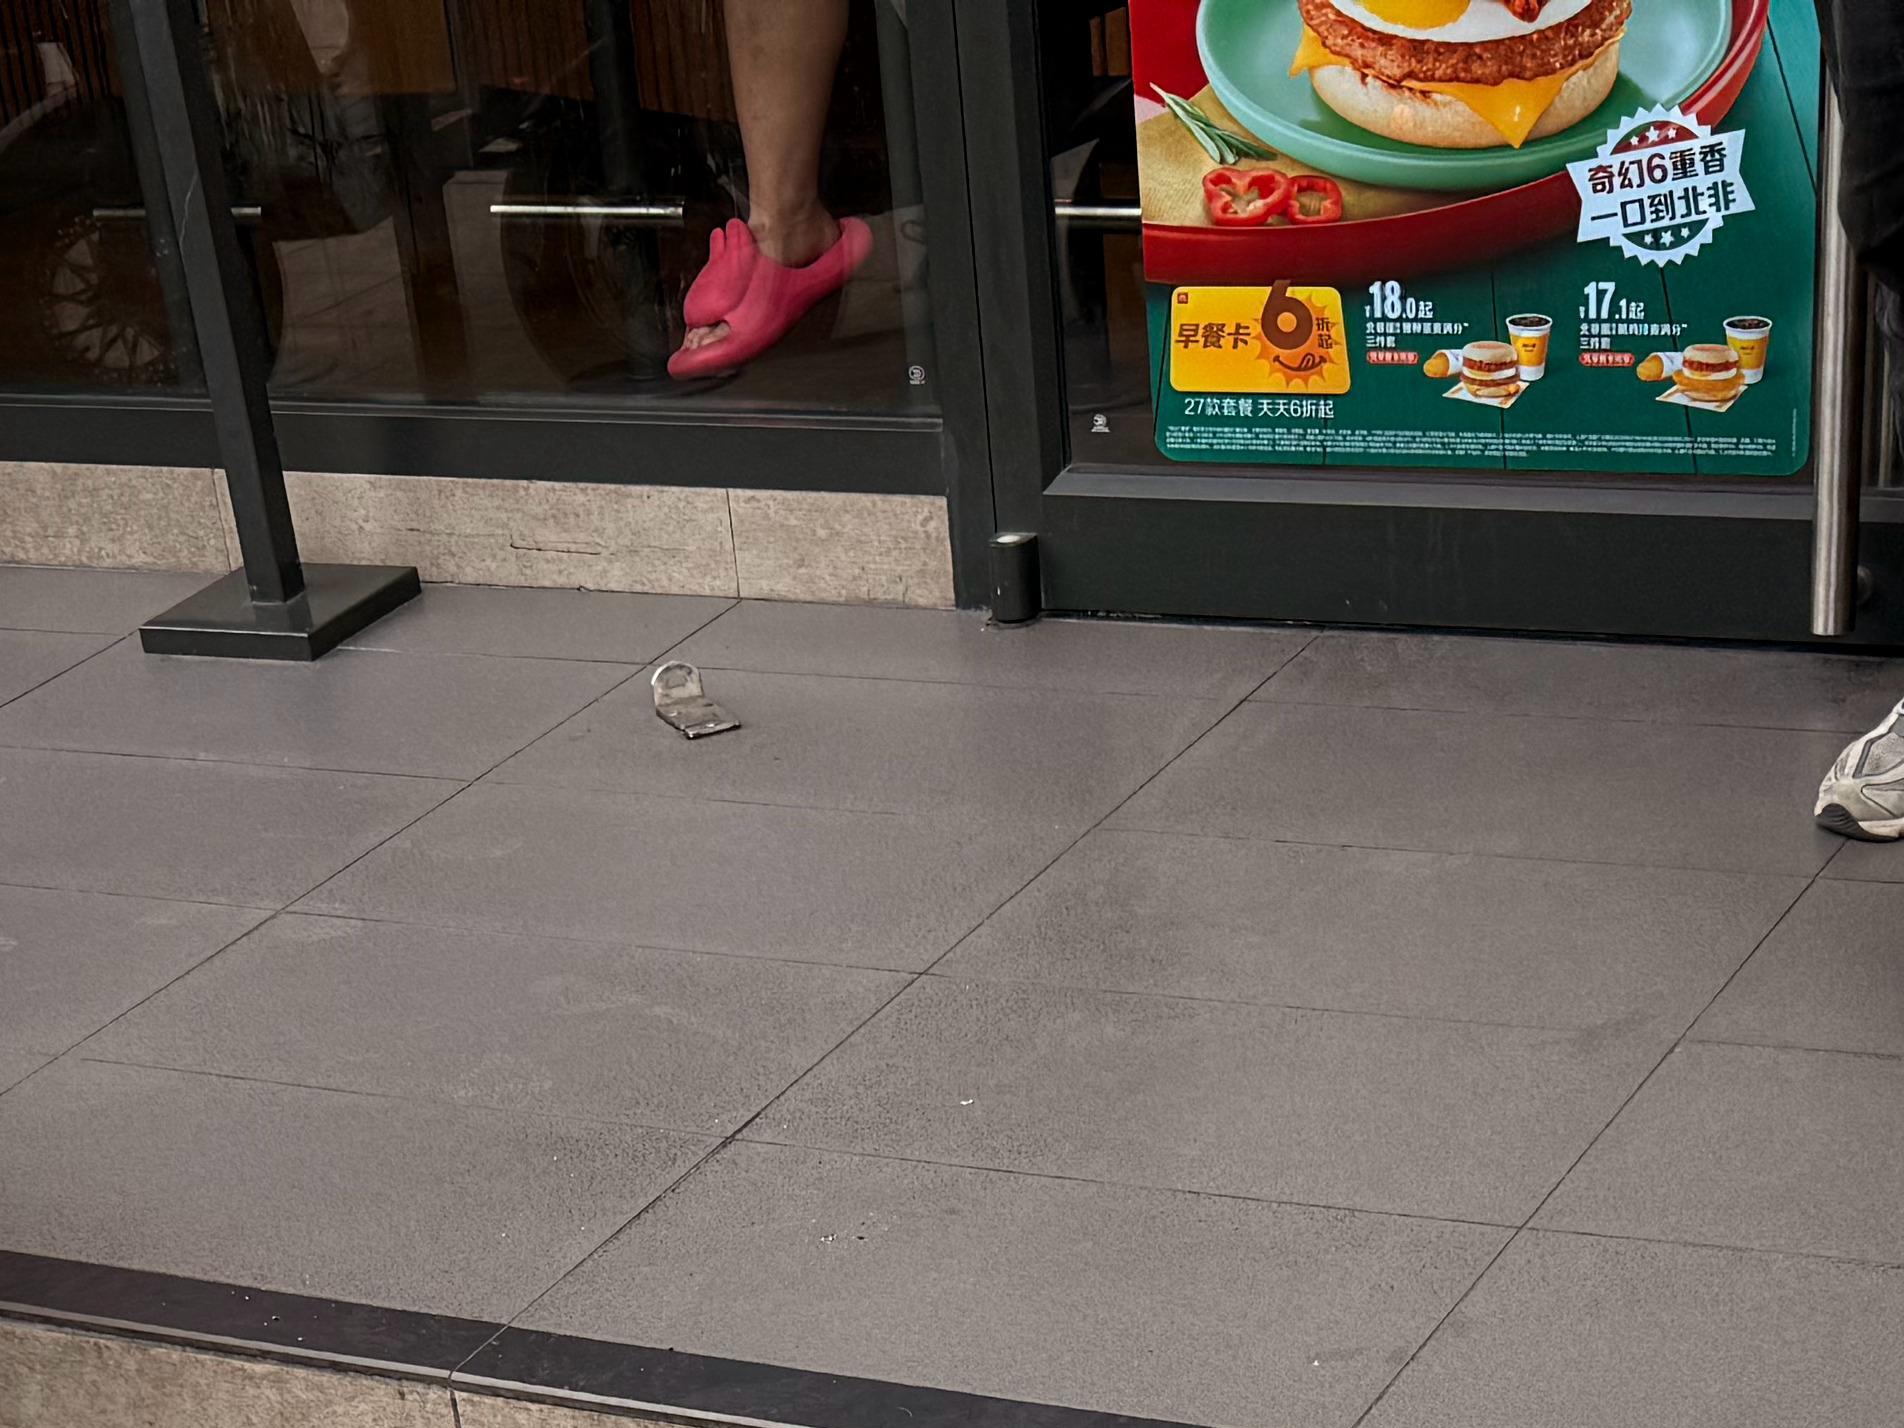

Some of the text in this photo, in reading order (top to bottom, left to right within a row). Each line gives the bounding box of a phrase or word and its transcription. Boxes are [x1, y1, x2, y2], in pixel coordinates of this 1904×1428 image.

[1587, 141, 1727, 195] 奇幻6重香
[1590, 179, 1737, 229] 一口到北非
[1175, 322, 1251, 350] 早餐卡
[1260, 279, 1314, 351] 6
[1257, 399, 1335, 419] 天天6折起
